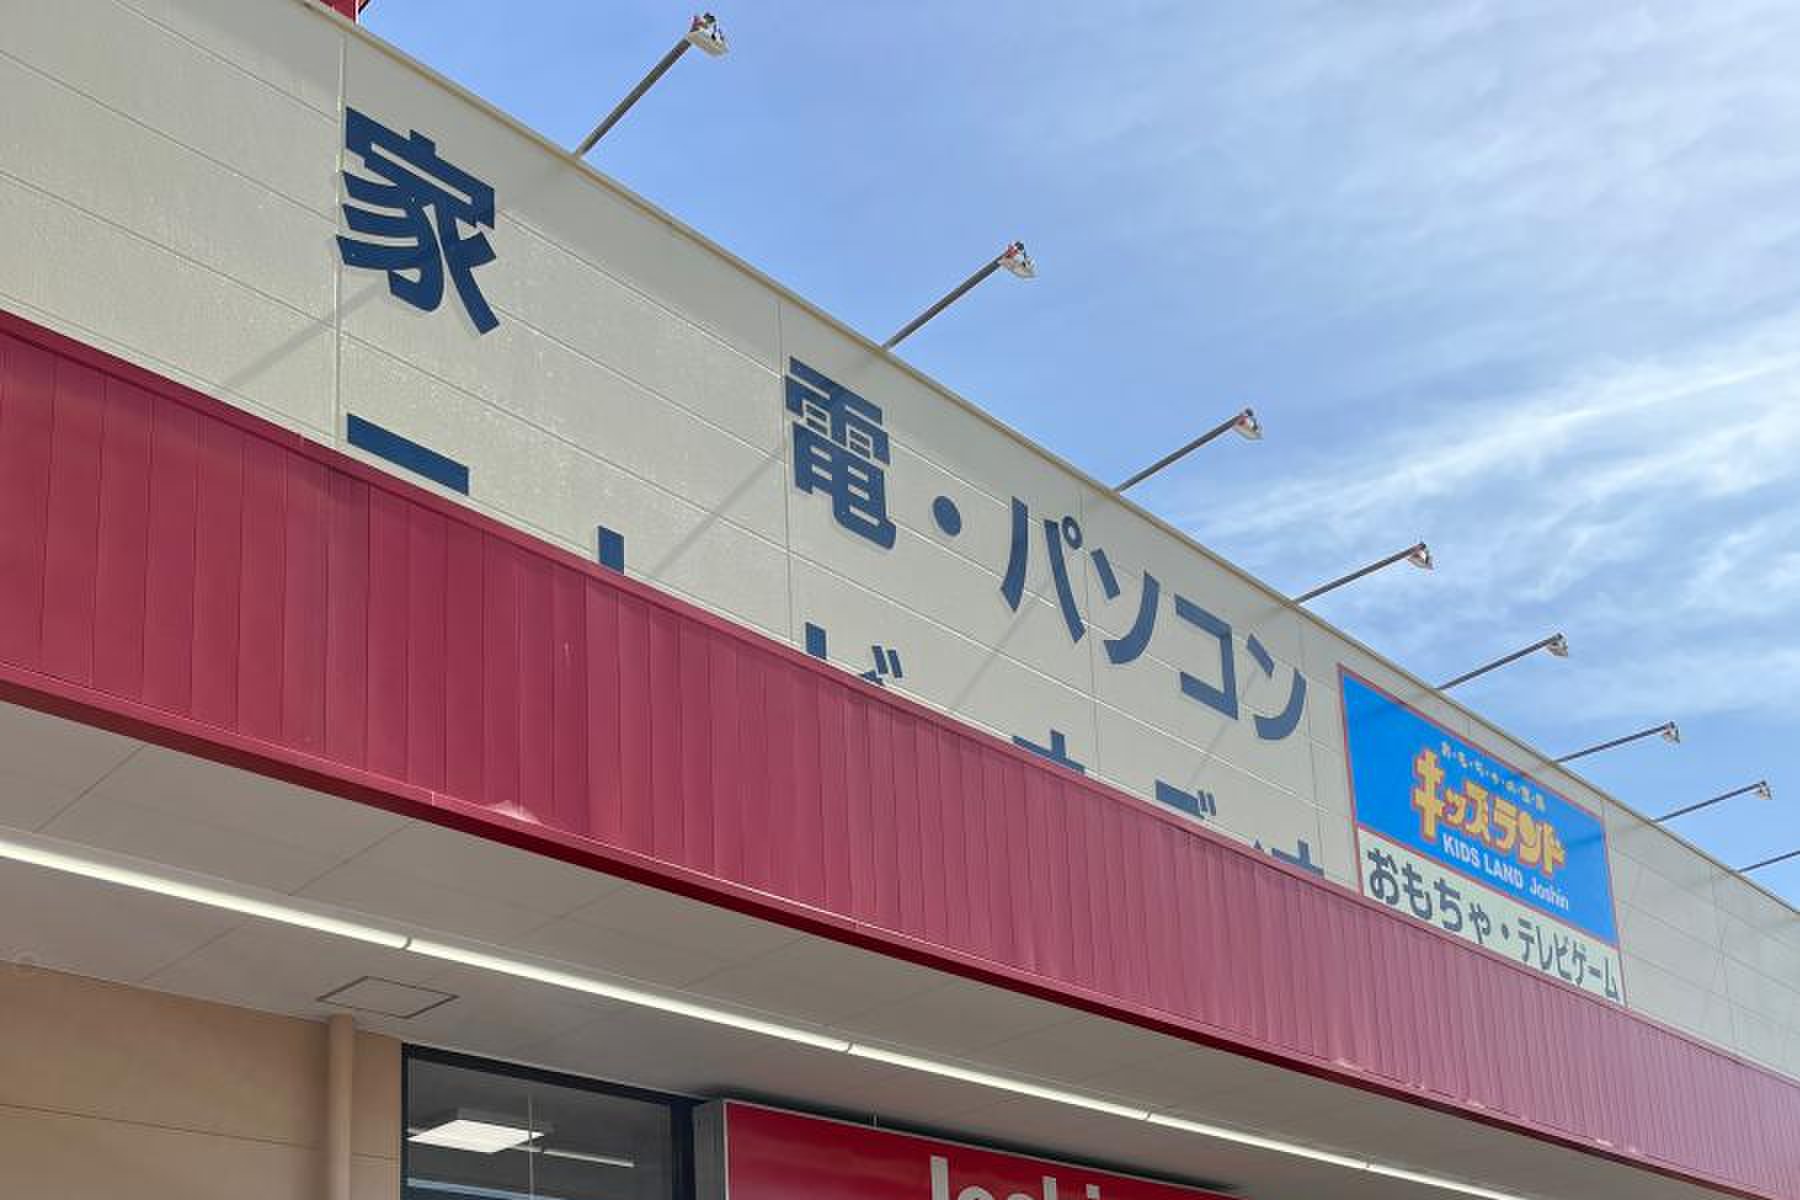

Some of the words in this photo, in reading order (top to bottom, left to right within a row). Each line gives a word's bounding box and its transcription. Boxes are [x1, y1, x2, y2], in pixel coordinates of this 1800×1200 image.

[336, 106, 500, 336] 家
[1367, 848, 1620, 1001] おもちゃ・テレビゲーム
[1442, 832, 1481, 868] KIDS
[1484, 853, 1524, 889] LAND
[1530, 877, 1569, 910] Joshin
